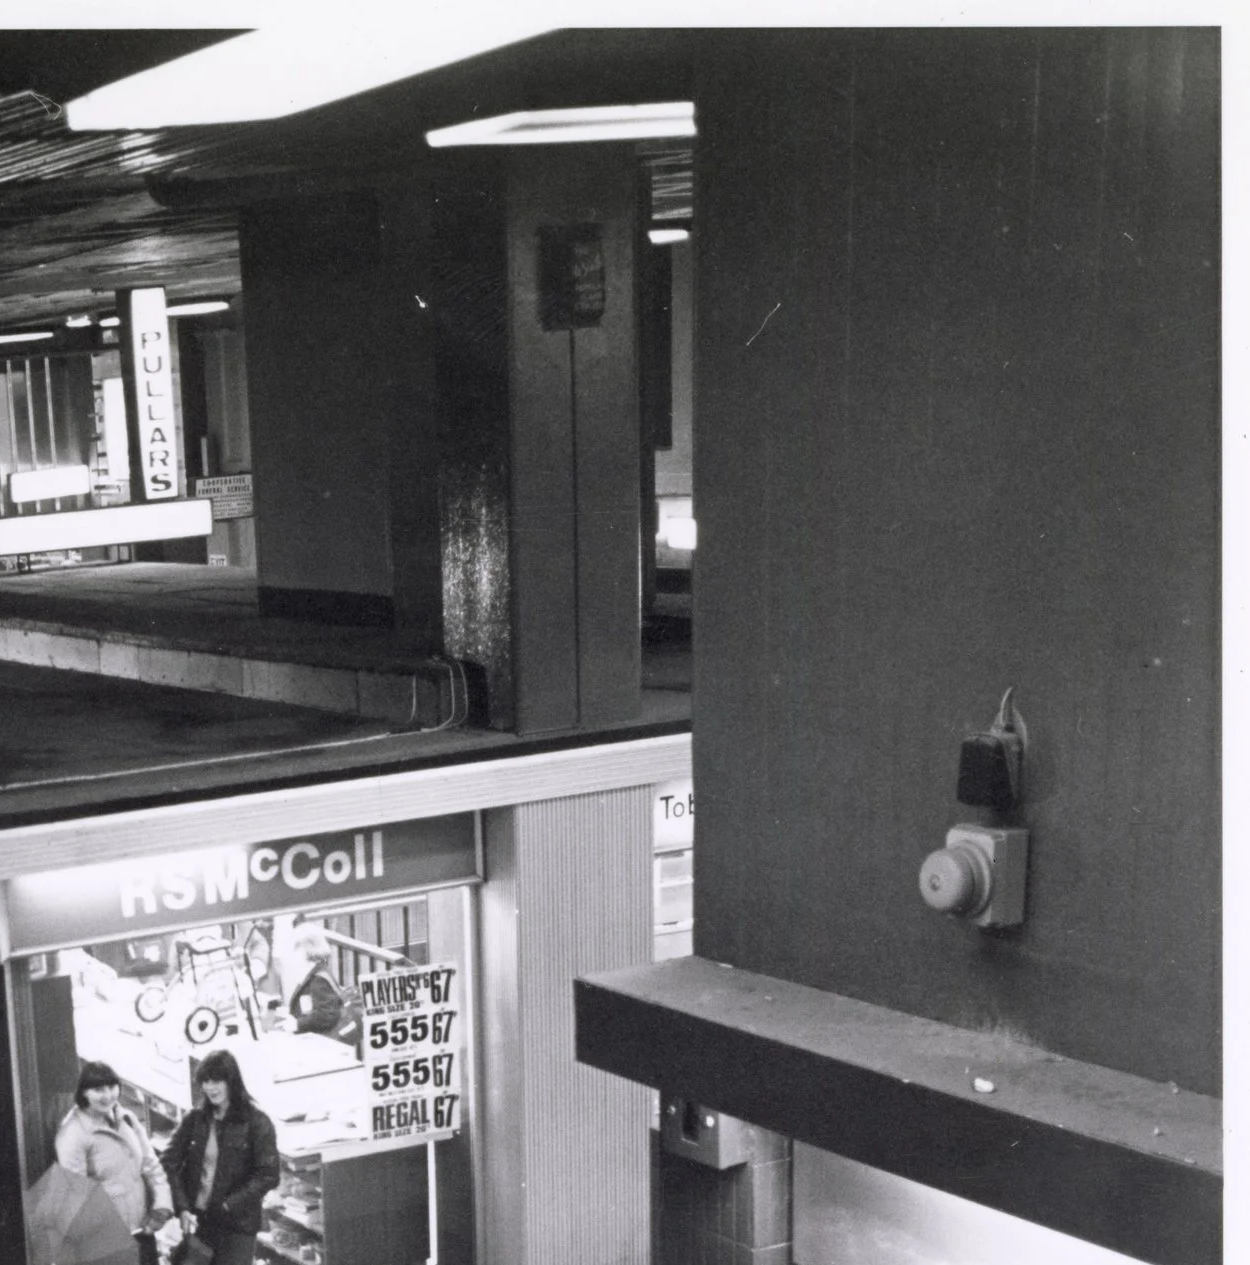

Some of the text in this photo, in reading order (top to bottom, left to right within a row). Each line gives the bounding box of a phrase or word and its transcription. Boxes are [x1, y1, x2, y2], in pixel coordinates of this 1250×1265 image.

[140, 331, 173, 493] PULLARS
[370, 1014, 429, 1050] 555
[371, 1052, 455, 1092] 555 67
[372, 1097, 431, 1133] REGAL
